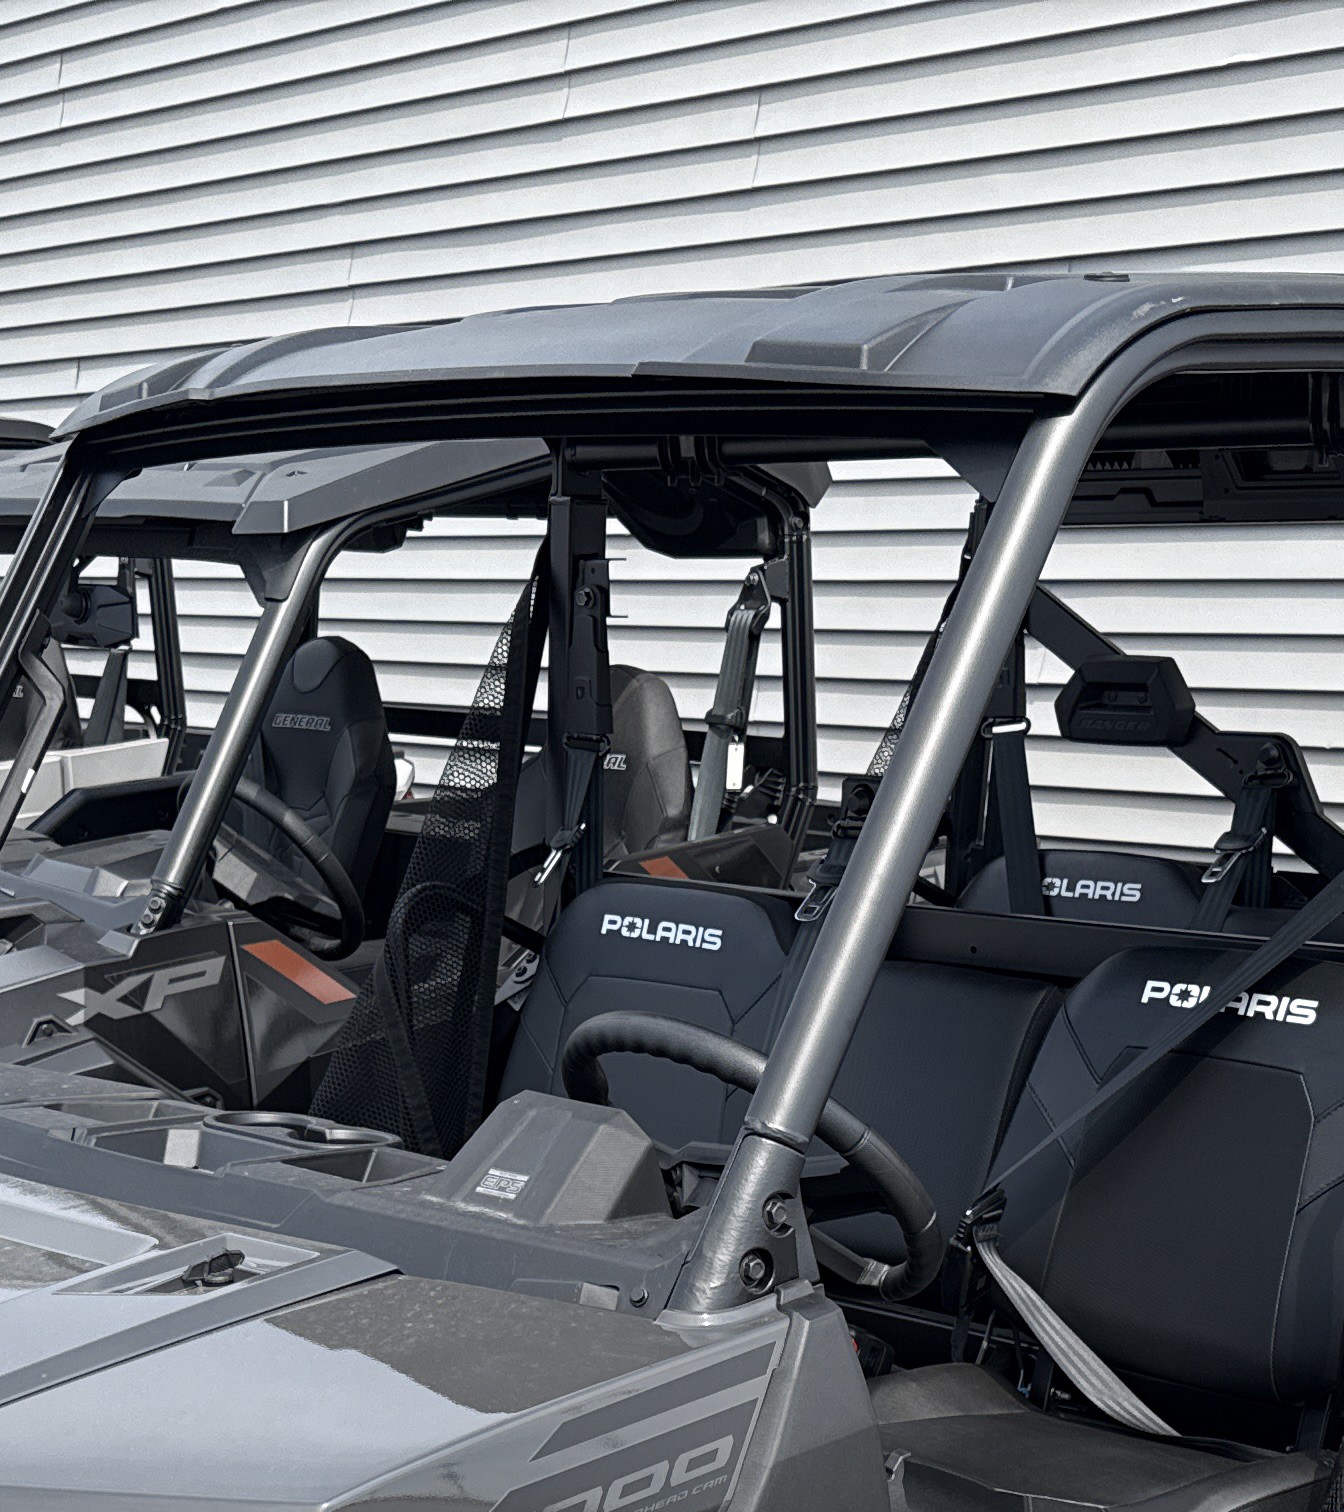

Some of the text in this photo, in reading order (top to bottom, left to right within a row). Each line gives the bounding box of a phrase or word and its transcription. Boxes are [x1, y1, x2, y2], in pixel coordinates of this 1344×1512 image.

[271, 713, 332, 732] GENERAL
[1040, 876, 1143, 903] OLARIS
[600, 913, 724, 952] POLARIS
[56, 954, 228, 1027] XP
[480, 1174, 527, 1194] EPS
[690, 1473, 729, 1496] CAM
